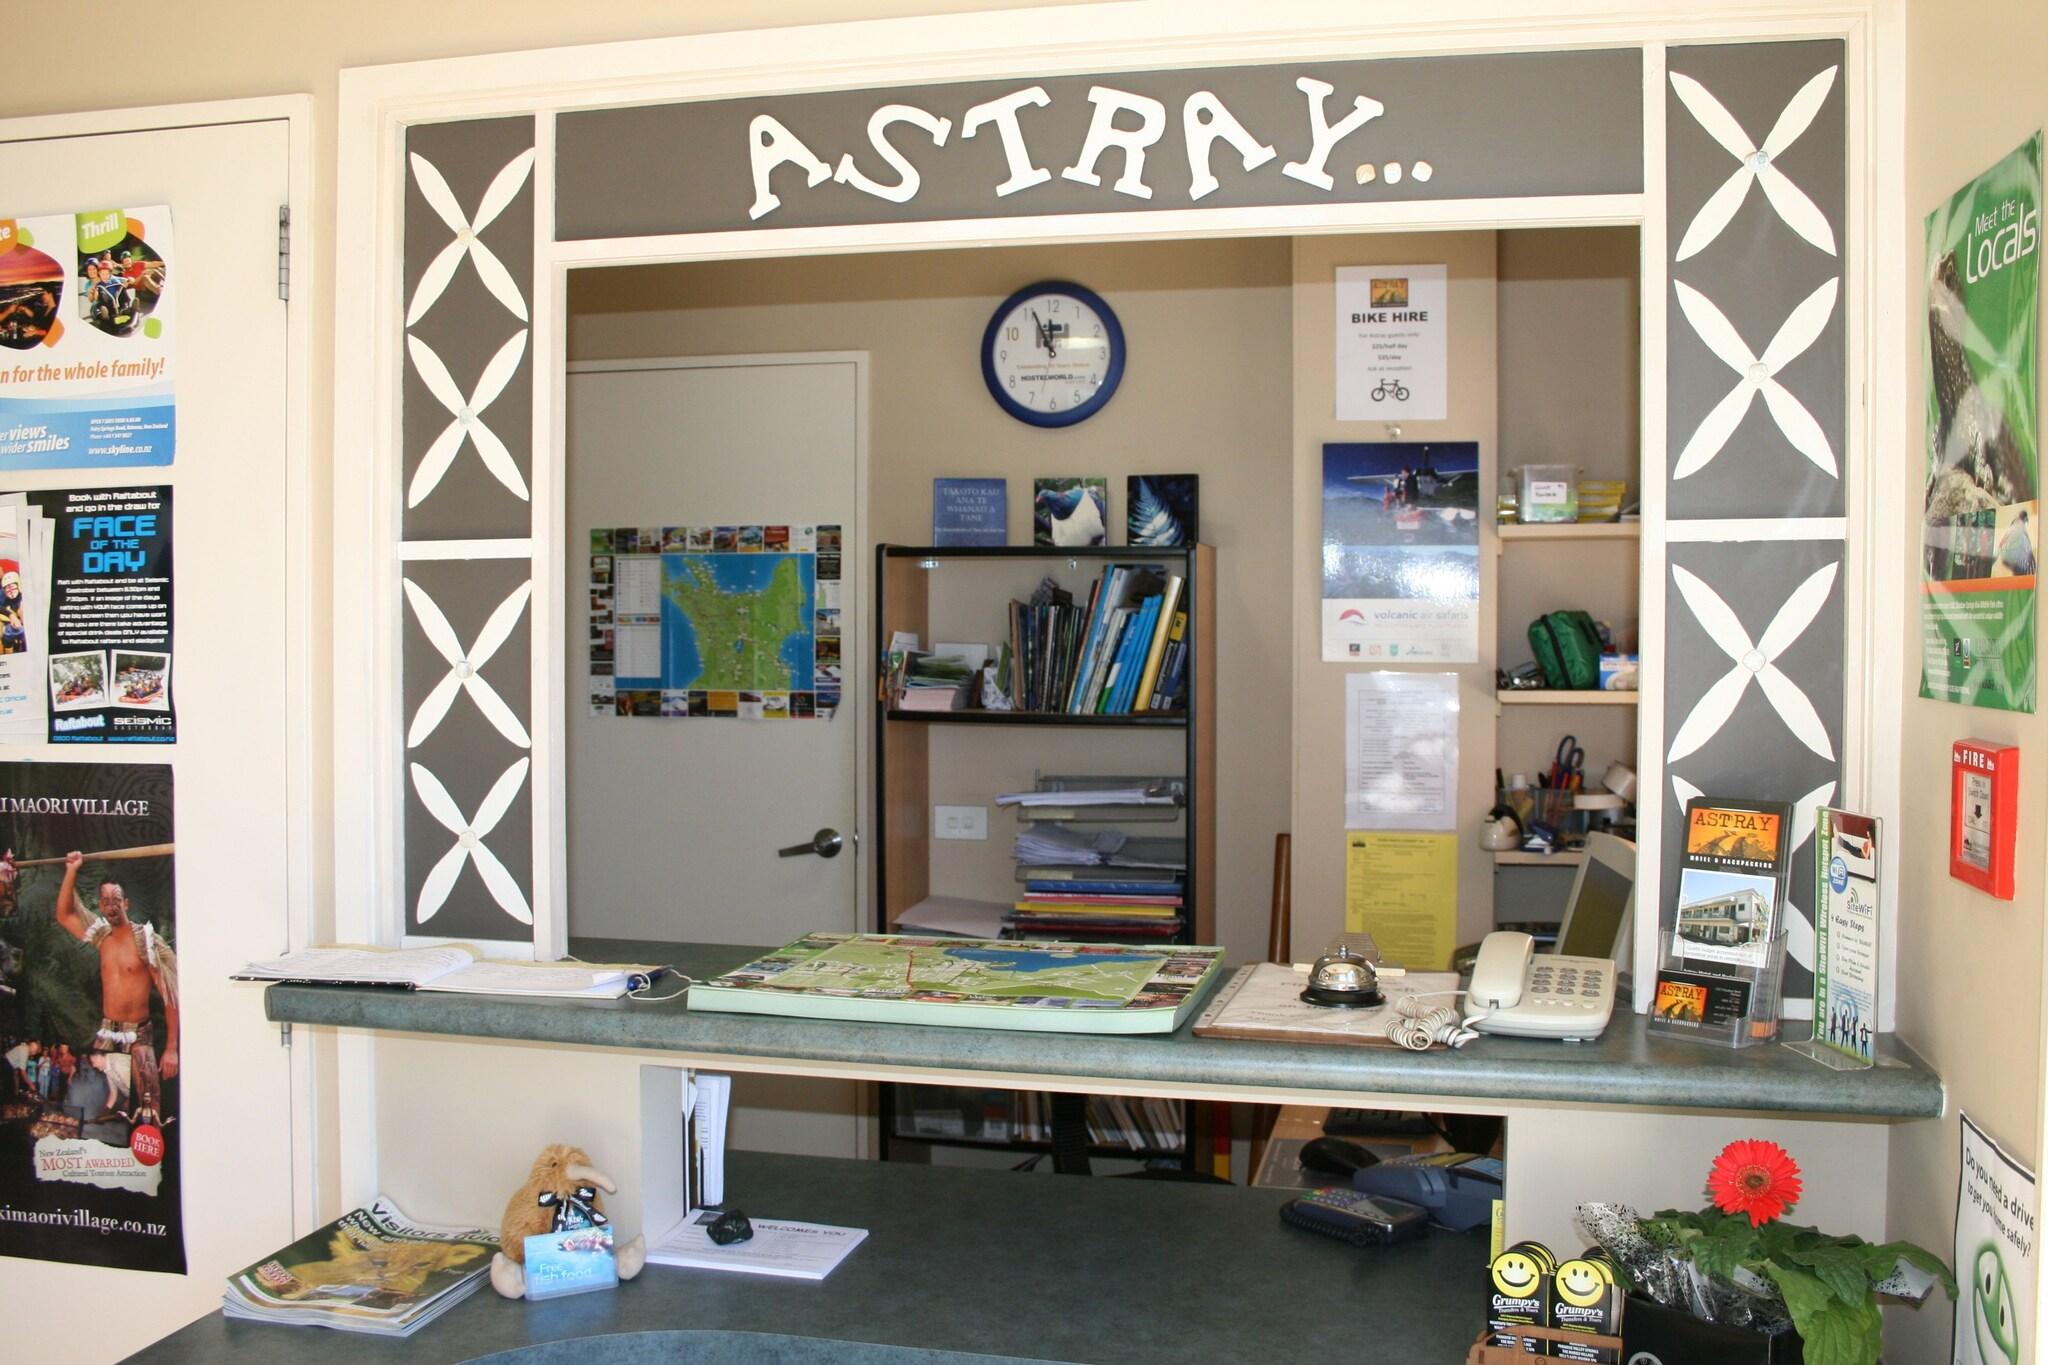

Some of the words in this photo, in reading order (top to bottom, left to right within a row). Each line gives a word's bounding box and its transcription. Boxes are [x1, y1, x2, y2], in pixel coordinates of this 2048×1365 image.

[1975, 207, 1998, 238] Meet
[2001, 199, 2016, 222] the
[80, 212, 119, 242] Thrill
[1966, 202, 2037, 285] Locals
[1047, 299, 1060, 313] 12
[1076, 305, 1081, 319] 1
[1351, 312, 1387, 323] BIKE
[1392, 311, 1429, 322] HIRE
[1006, 327, 1019, 342] 10
[1093, 324, 1100, 338] 2
[1000, 350, 1007, 363] 9
[1099, 346, 1106, 360] 3
[12, 365, 35, 384] for
[37, 363, 61, 382] the
[64, 360, 109, 381] whole
[111, 356, 166, 381] family!
[1009, 375, 1016, 389] 8
[1089, 373, 1097, 386] 4
[1029, 391, 1036, 405] 7
[1049, 396, 1057, 410] 6
[1073, 389, 1081, 404] 5
[10, 424, 47, 440] views
[27, 434, 71, 454] smiles
[69, 494, 93, 502] Book
[93, 492, 112, 501] with
[113, 491, 157, 500] Raftabout
[66, 505, 84, 513] and
[85, 504, 97, 513] go
[98, 503, 106, 512] in
[107, 503, 123, 511] the
[124, 502, 147, 511] draw
[148, 501, 161, 510] for
[73, 514, 157, 539] FACE
[90, 539, 109, 550] OF
[112, 538, 140, 550] THE
[83, 551, 146, 574] DAY
[1374, 609, 1418, 620] volcanic
[54, 714, 106, 732] Raftabout
[1962, 749, 1985, 769] FIRE
[11, 798, 70, 814] MAORI
[71, 798, 150, 817] VILLAGE
[1694, 811, 1773, 832] ASTRAY
[1835, 914, 1849, 929] Easy
[1850, 919, 1865, 933] Steps
[1661, 984, 1703, 1001] ASTRAY
[1816, 1020, 1825, 1040] You
[136, 1132, 160, 1148] BOOK
[39, 1150, 54, 1158] New
[56, 1147, 87, 1157] Zealand's
[134, 1142, 160, 1157] HERE
[42, 1157, 83, 1171] MOST
[85, 1158, 135, 1169] AWARDED
[1966, 1147, 1975, 1170] Do
[1976, 1161, 1989, 1185] you
[1989, 1176, 2002, 1204] need
[2003, 1194, 2009, 1210] a
[355, 1209, 382, 1236] New
[372, 1202, 448, 1240] Visitors
[1968, 1181, 1973, 1196] to
[1972, 1189, 1982, 1206] get
[1982, 1199, 1993, 1217] you
[1993, 1208, 2006, 1235] home
[2007, 1228, 2031, 1257] safely?
[758, 1224, 818, 1234] WELCOMES
[562, 1266, 593, 1280] food
[1492, 1294, 1540, 1309] Grumpy's
[1555, 1302, 1604, 1317] Grumpy's
